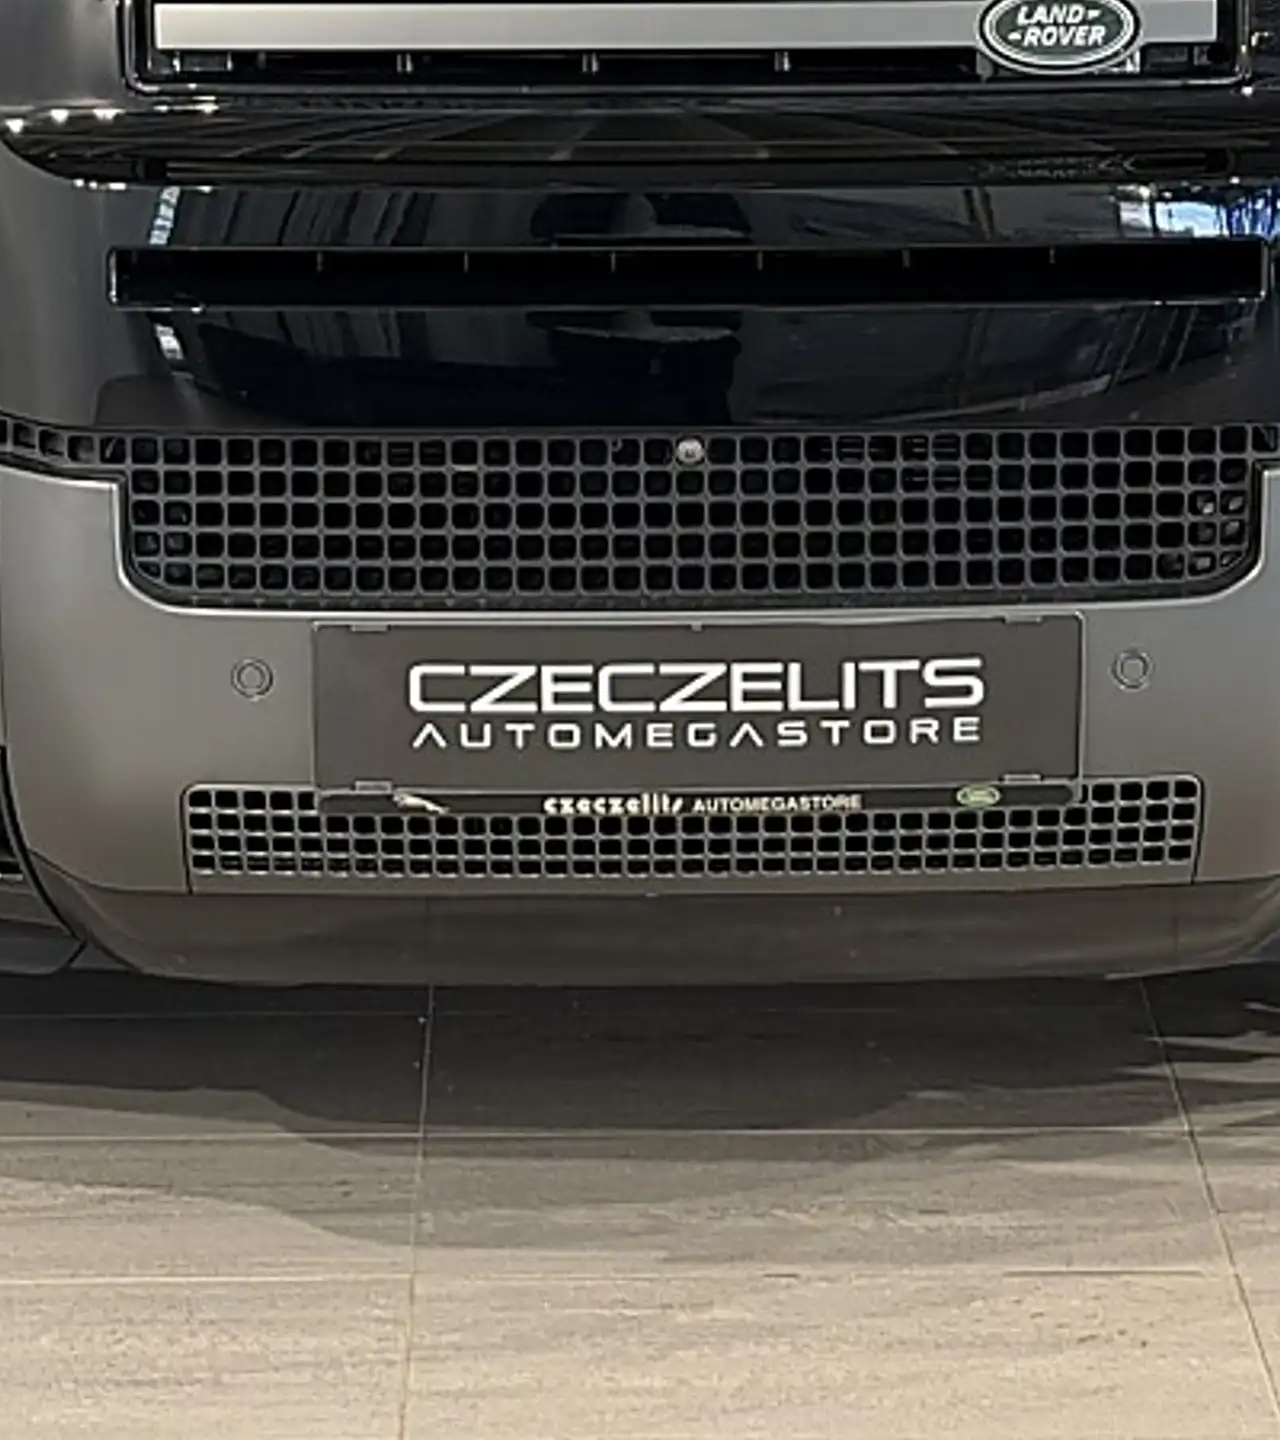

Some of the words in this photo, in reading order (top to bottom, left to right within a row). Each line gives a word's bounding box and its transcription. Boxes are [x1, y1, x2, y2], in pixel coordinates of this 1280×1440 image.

[1017, 3, 1086, 25] LAND
[1023, 24, 1106, 47] ROVER
[408, 658, 986, 714] CZECZELITS
[412, 717, 984, 749] AUTOMEGASTORE
[692, 793, 863, 813] AUTOMEGASTORE
